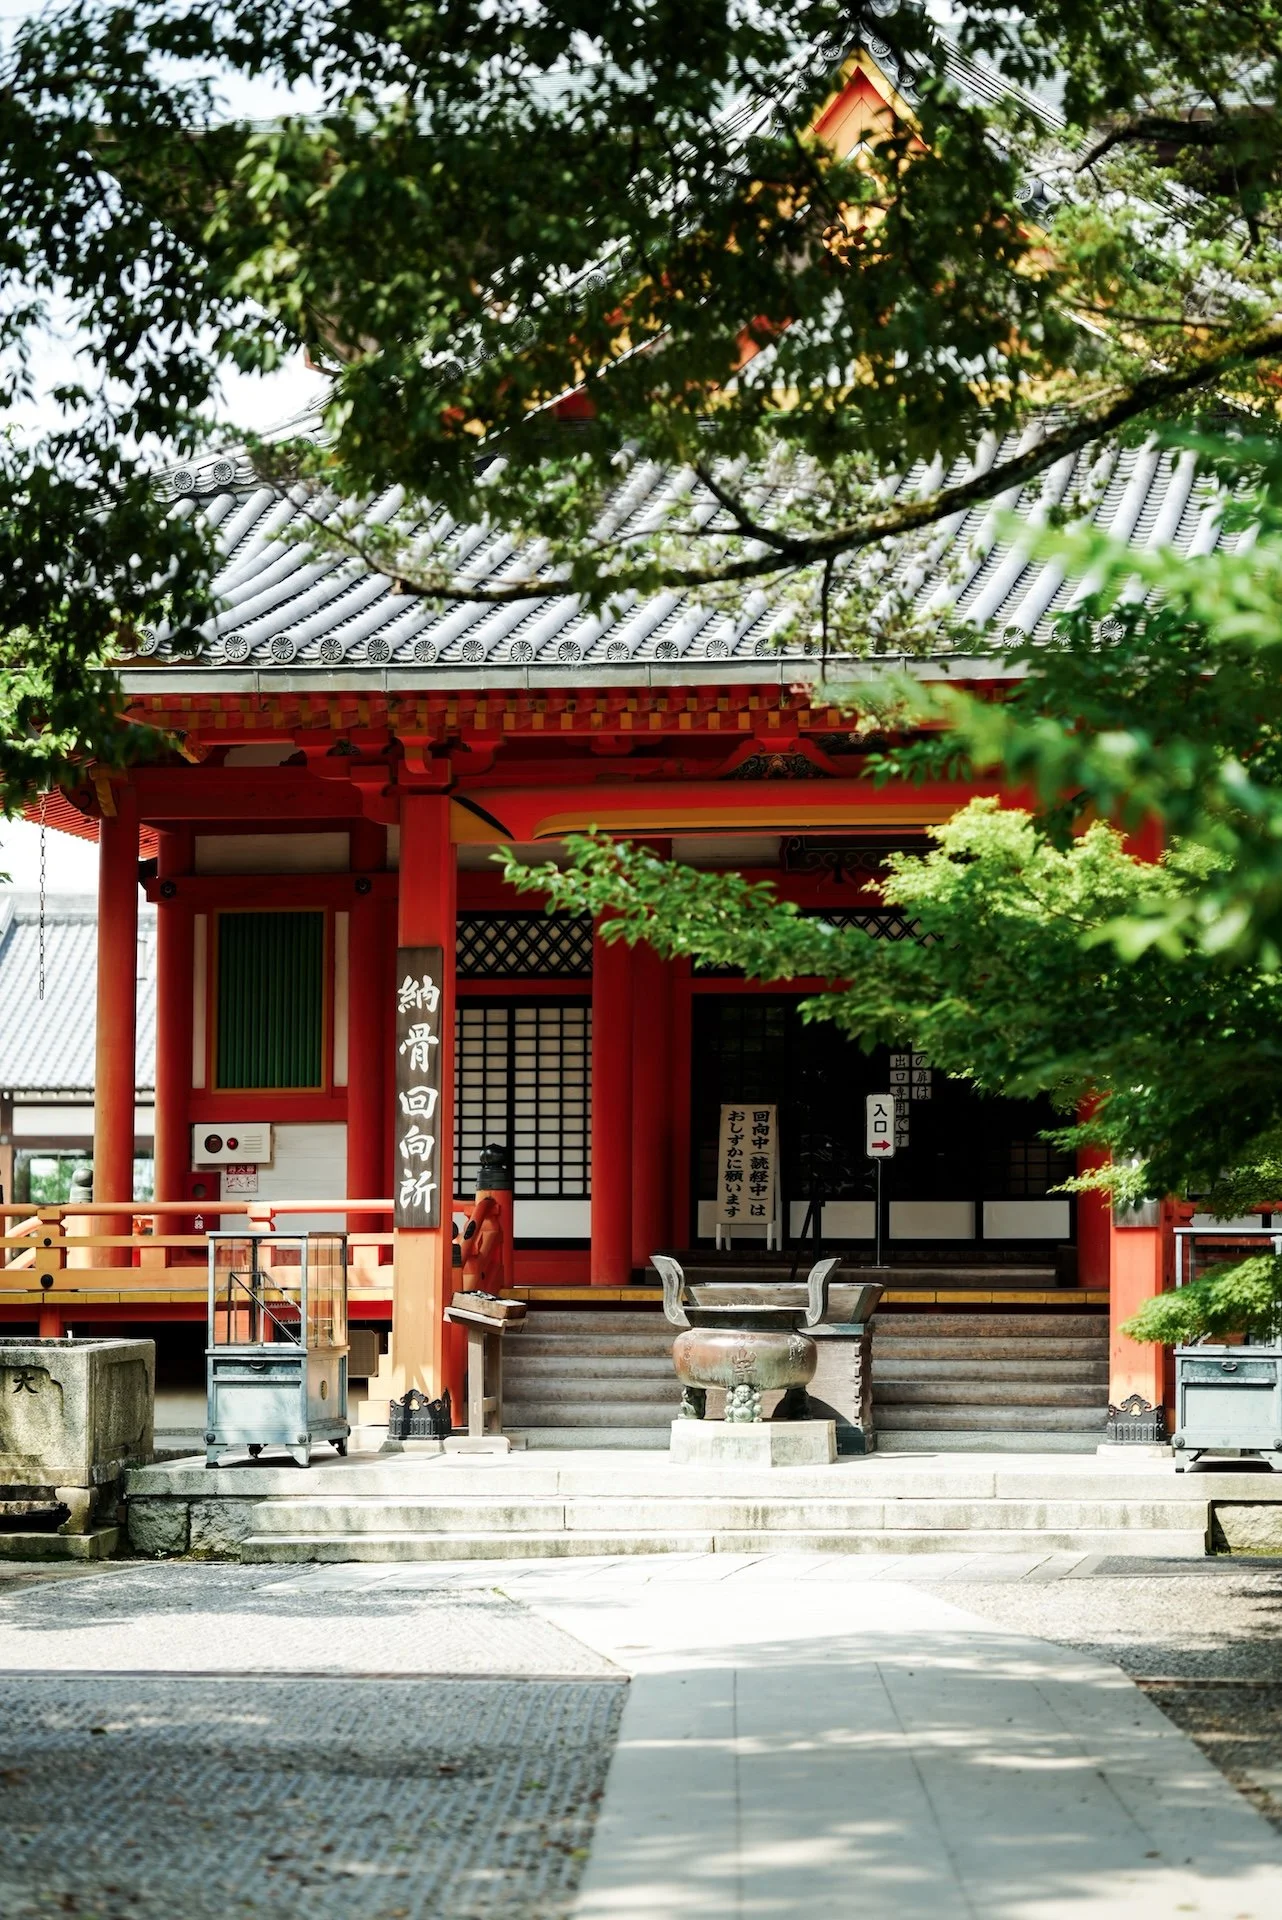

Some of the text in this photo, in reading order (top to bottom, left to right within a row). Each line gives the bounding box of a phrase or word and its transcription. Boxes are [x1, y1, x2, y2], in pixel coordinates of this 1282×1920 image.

[398, 975, 441, 1213] 納骨回向所
[874, 1104, 888, 1133] 入口
[724, 1110, 746, 1218] おしずかに願います
